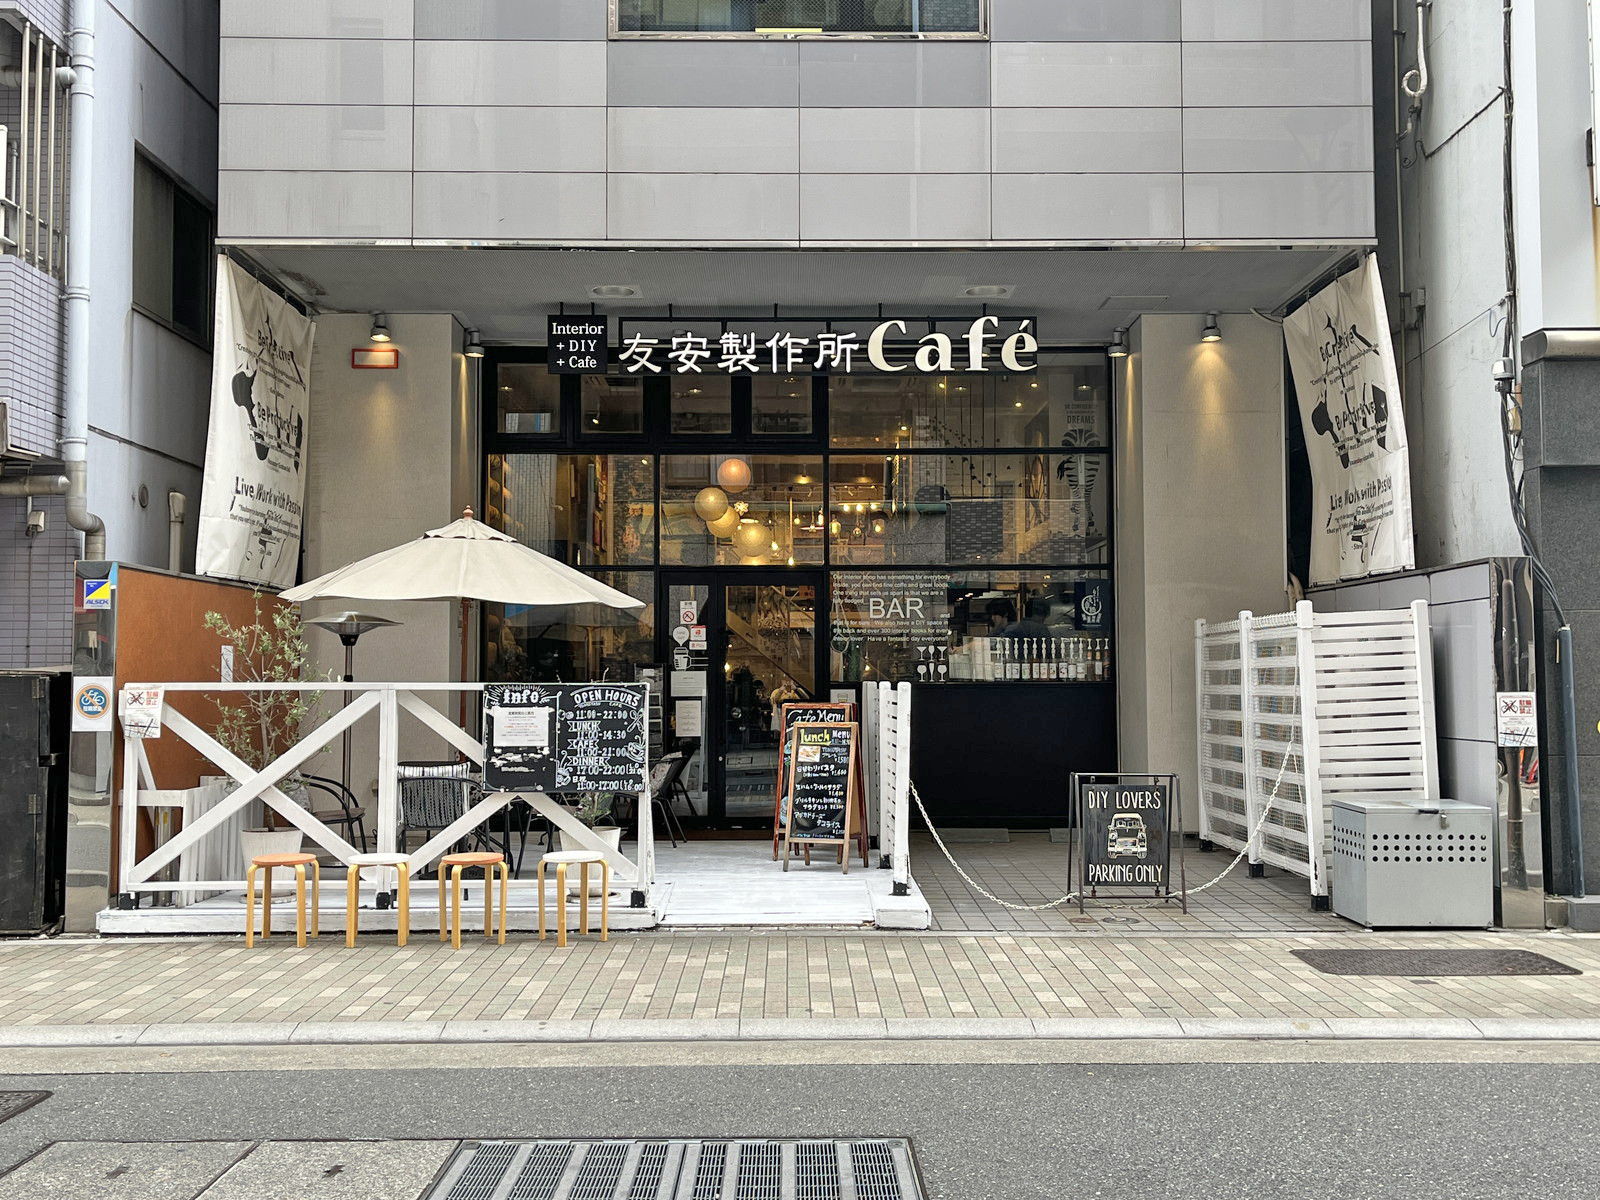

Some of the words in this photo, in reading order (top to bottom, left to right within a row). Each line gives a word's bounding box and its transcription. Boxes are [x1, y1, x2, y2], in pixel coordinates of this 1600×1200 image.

[552, 322, 604, 335] Interior
[569, 340, 597, 351] DIY
[619, 331, 860, 374] 友安製作所
[867, 315, 1038, 372] Café
[569, 356, 597, 368] Cafe
[1067, 415, 1095, 424] DREAMS
[869, 597, 924, 618] BAR
[574, 690, 602, 704] OPEN
[605, 689, 640, 707] HOURS
[572, 723, 597, 732] LUNCH
[573, 740, 594, 749] CAFE
[573, 757, 606, 766] DINNER
[1088, 791, 1108, 809] DIY
[1116, 791, 1161, 809] LOVERS
[1088, 864, 1133, 882] PARKING
[1135, 864, 1163, 882] ONLY
